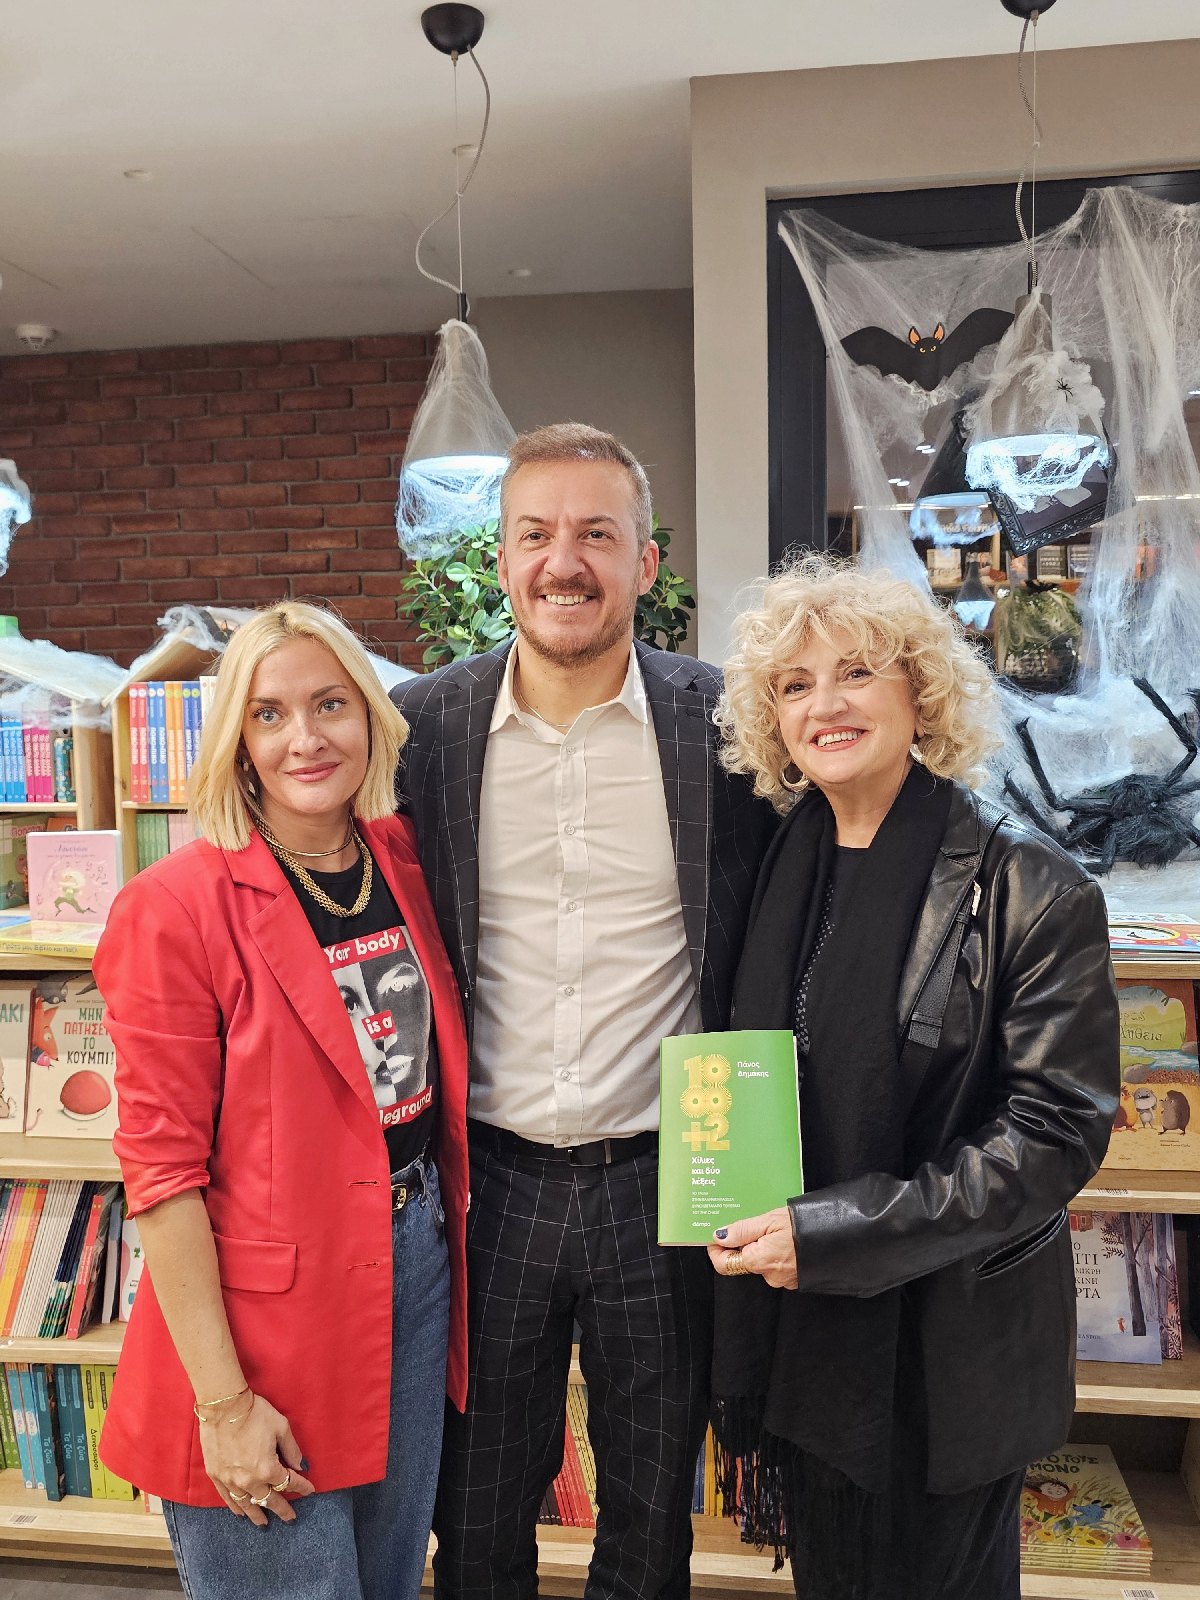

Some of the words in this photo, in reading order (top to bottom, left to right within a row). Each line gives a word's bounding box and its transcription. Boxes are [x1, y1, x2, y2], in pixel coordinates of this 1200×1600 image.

[354, 930, 400, 956] body
[0, 1003, 24, 1023] ΑΚΙ
[79, 1008, 103, 1021] ΜΗΝ
[365, 1018, 380, 1035] is
[382, 1016, 393, 1029] a
[83, 1037, 96, 1049] ΤΟ
[66, 1051, 114, 1065] ΚΟΥΜΠΙ!
[737, 1060, 760, 1069] Πάνος
[737, 1070, 769, 1078] Δημάκης
[691, 1155, 715, 1165] Χίλιες
[705, 1166, 720, 1175] δύο
[691, 1177, 716, 1187] λέξεις
[43, 1436, 51, 1447] Τα
[63, 1432, 71, 1444] Τα
[77, 1433, 85, 1445] Τα
